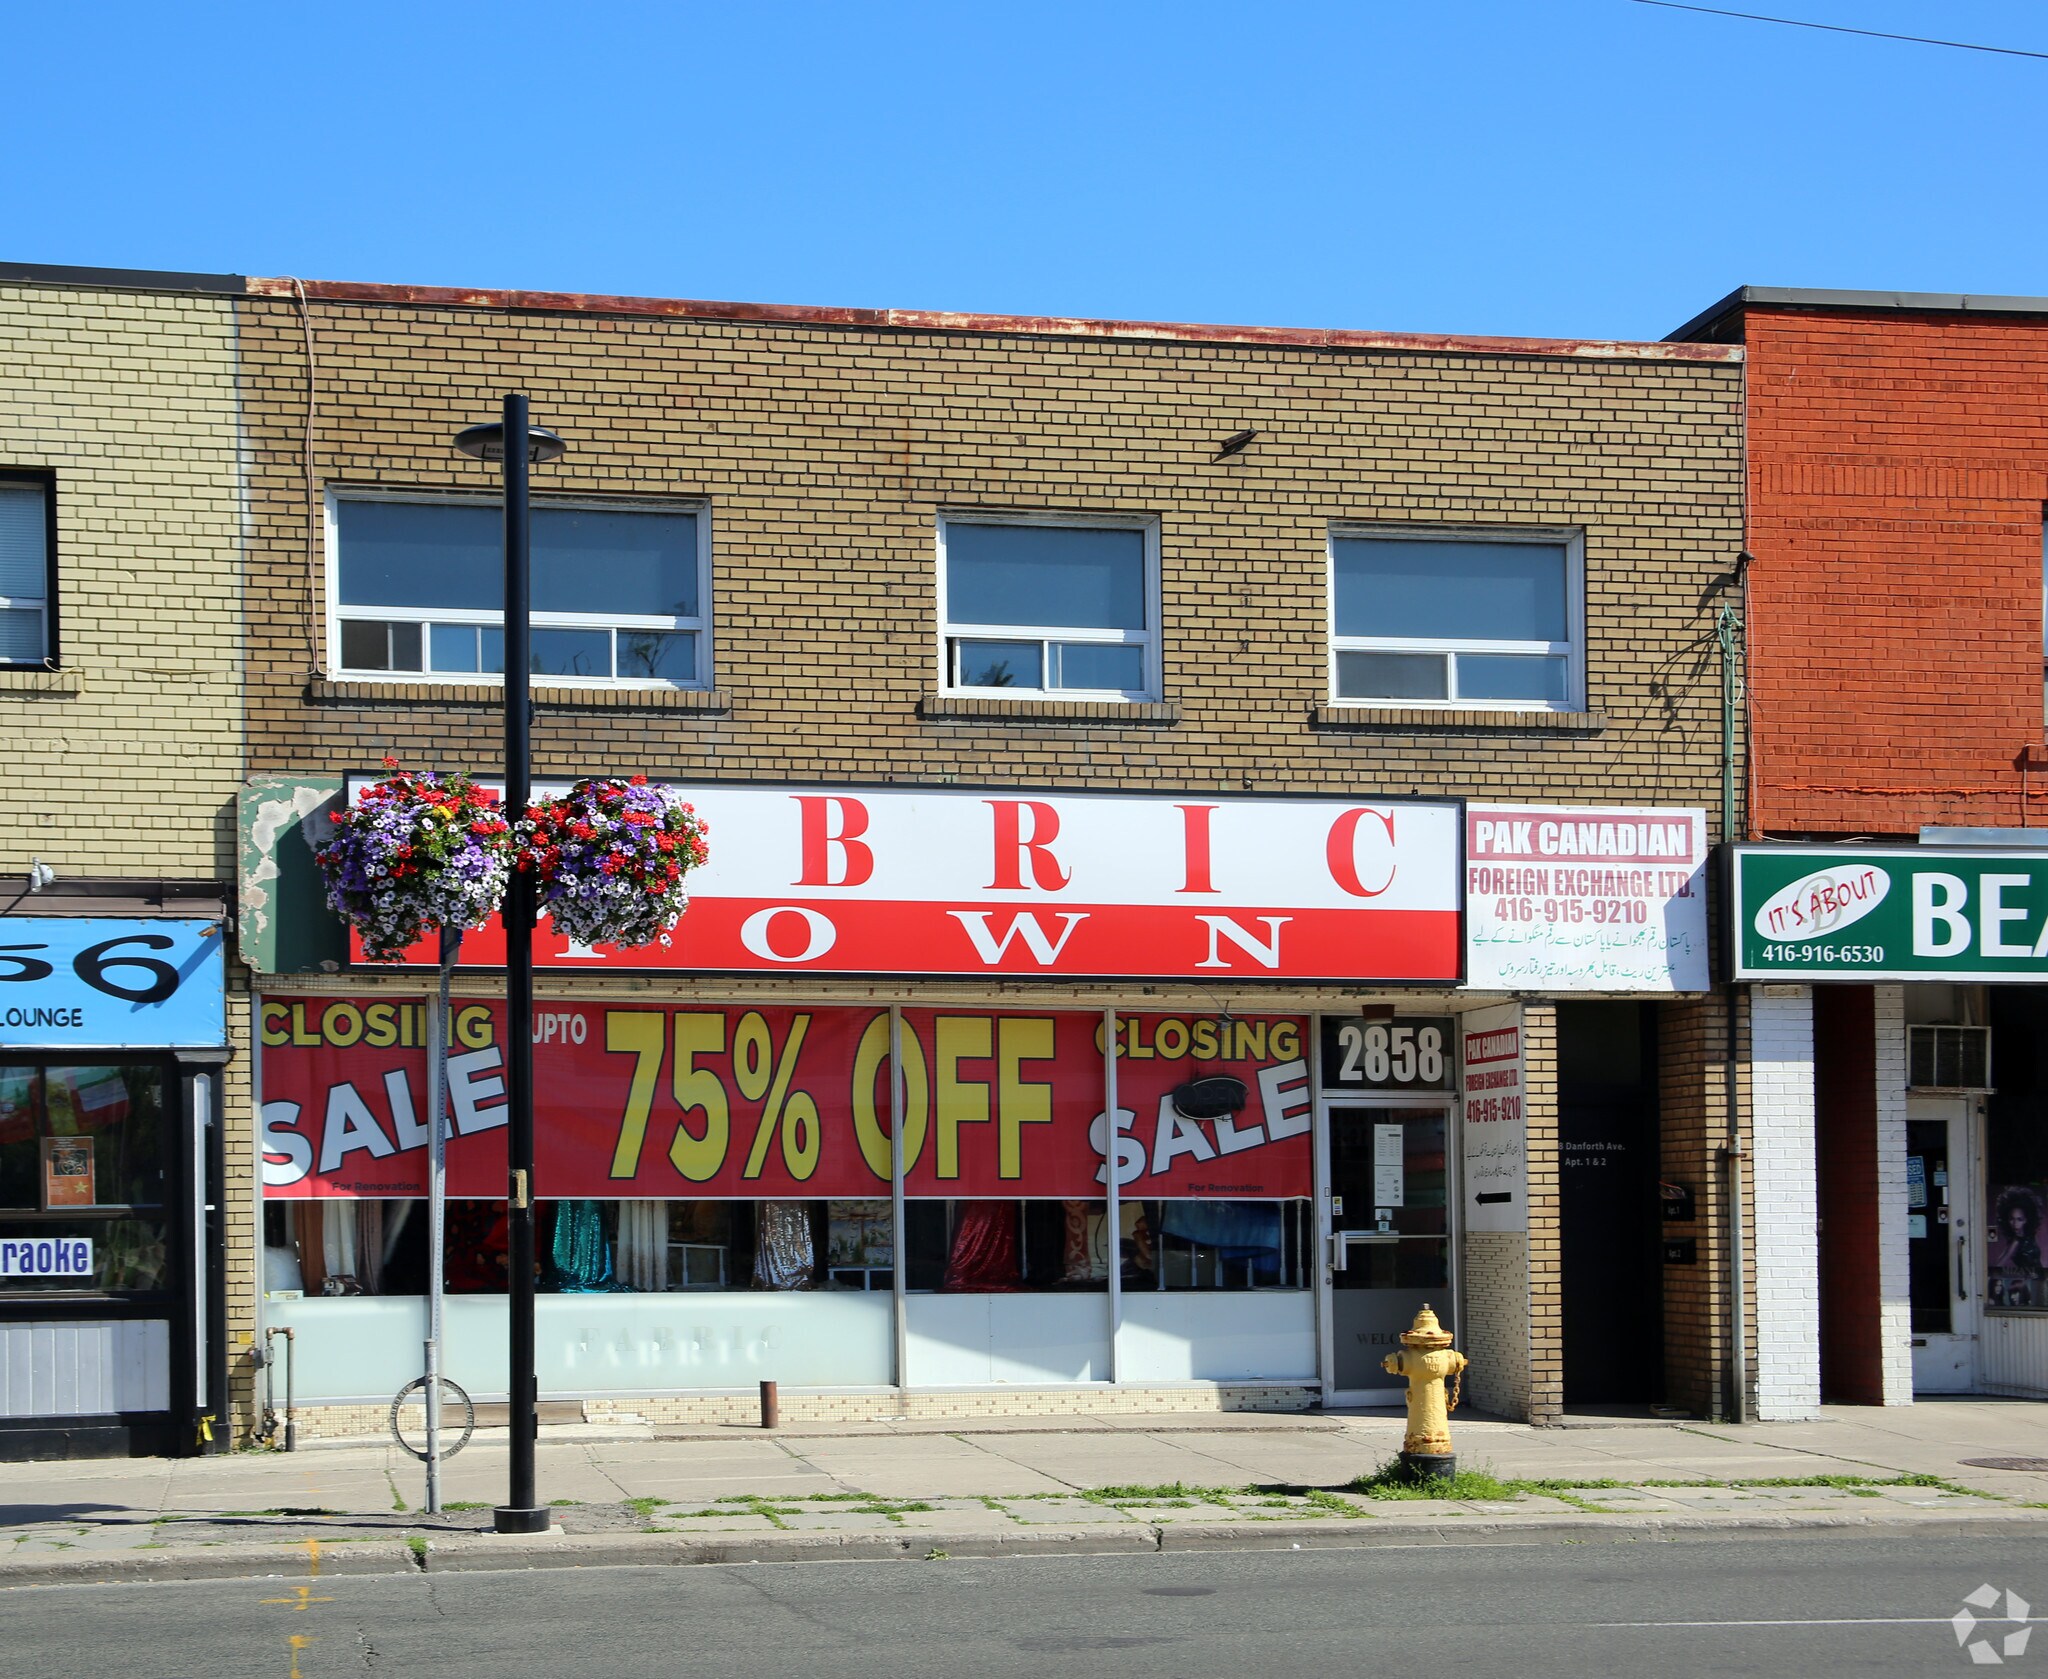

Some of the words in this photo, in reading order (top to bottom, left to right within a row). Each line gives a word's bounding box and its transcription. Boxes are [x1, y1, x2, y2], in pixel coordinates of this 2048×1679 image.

[1475, 820, 1532, 854] PAK
[1538, 821, 1686, 857] CANADIAN
[1468, 867, 1548, 896] FOREIGN
[1554, 869, 1653, 898] EXCHANGE
[1658, 871, 1696, 898] LTD.
[1494, 897, 1648, 924] 416-915-9210
[1768, 899, 1805, 935] IT'S
[1810, 871, 1878, 921] ABOUT
[1912, 872, 2048, 958] BE
[1763, 945, 1884, 963] 416-916-6530
[0, 1008, 83, 1027] OUNGE
[532, 1012, 588, 1045] UPTO
[1094, 1017, 1300, 1062] CLOSING
[1338, 1025, 1444, 1082] 2858
[1466, 1037, 1482, 1061] PAK
[1482, 1032, 1518, 1059] CANADIAN
[605, 1010, 821, 1182] 75%
[851, 1011, 1056, 1182] OFF
[1465, 1072, 1485, 1092] FOREIGN
[261, 1046, 508, 1187] SALE
[1088, 1058, 1312, 1186] SALE
[1466, 1095, 1521, 1124] 416-915-9210
[1565, 1141, 1604, 1150] Danforth
[1606, 1142, 1626, 1151] Ave.
[1564, 1157, 1583, 1168] Apt.
[1592, 1157, 1600, 1166] &
[1601, 1157, 1607, 1166] 2
[332, 1182, 353, 1192] For
[355, 1181, 421, 1192] Renovation
[1188, 1184, 1205, 1193] For
[1208, 1184, 1265, 1193] Renovation
